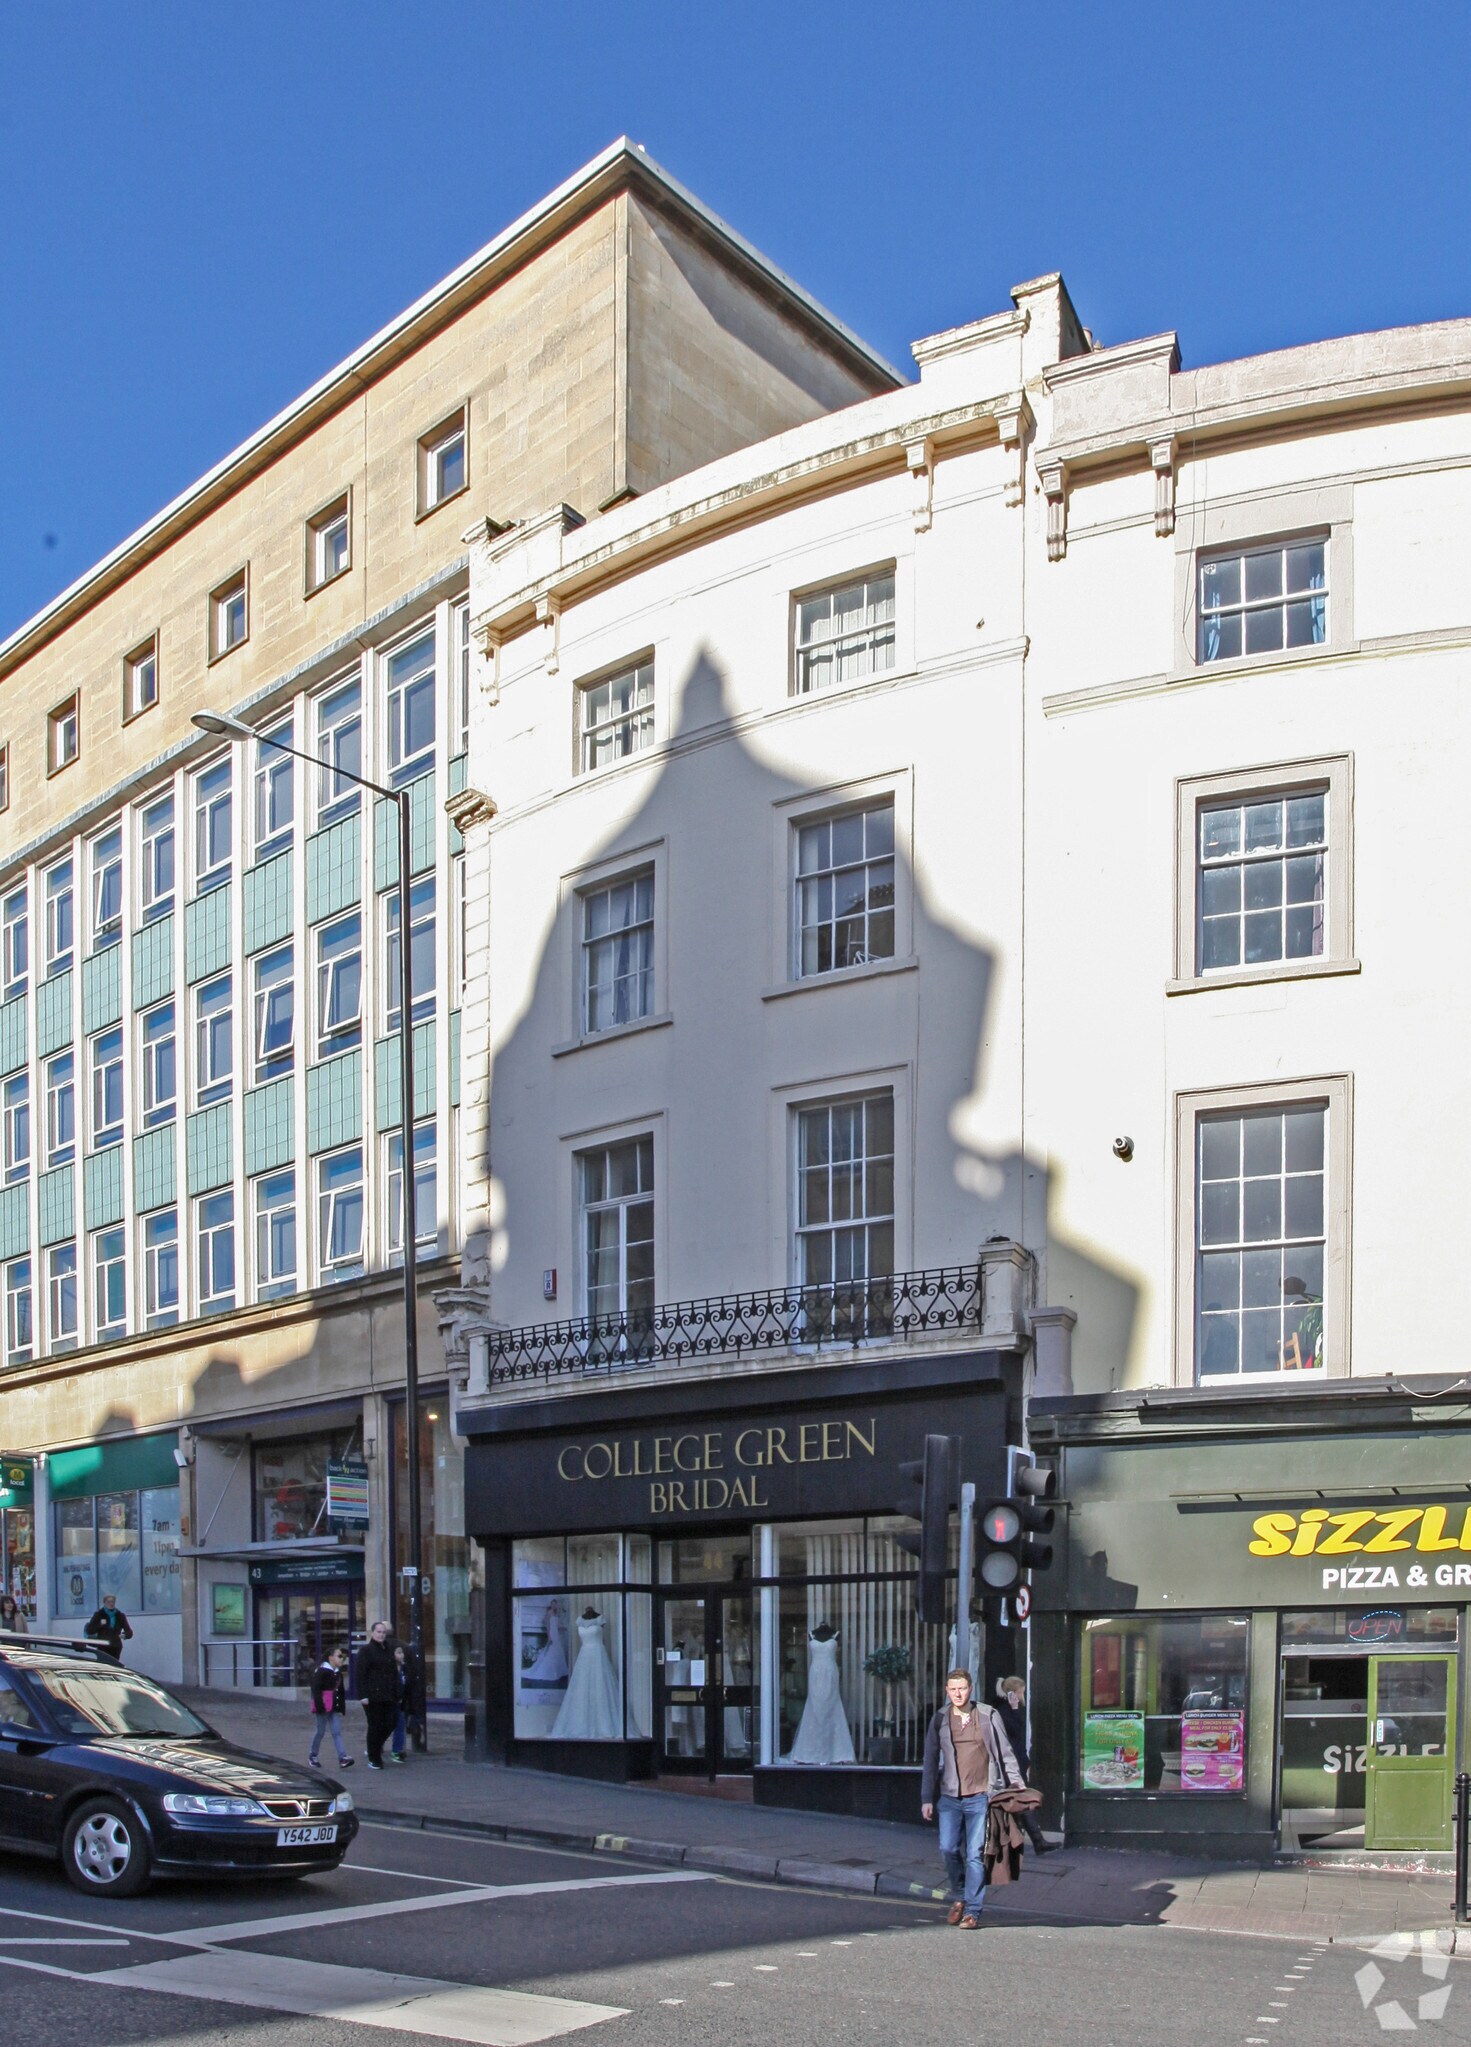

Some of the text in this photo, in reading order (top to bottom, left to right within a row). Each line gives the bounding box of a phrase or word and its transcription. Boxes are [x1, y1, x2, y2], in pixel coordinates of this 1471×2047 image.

[558, 1419, 876, 1481] COLLEGE GREEN
[650, 1475, 768, 1513] BRIDAL
[152, 1519, 170, 1532] 7am
[144, 1559, 182, 1578] every da
[252, 1568, 262, 1579] 43
[1322, 1566, 1400, 1590] PIZZA
[1406, 1564, 1429, 1587] &
[1349, 1619, 1402, 1636] OPEN
[283, 1828, 312, 1842] Y542
